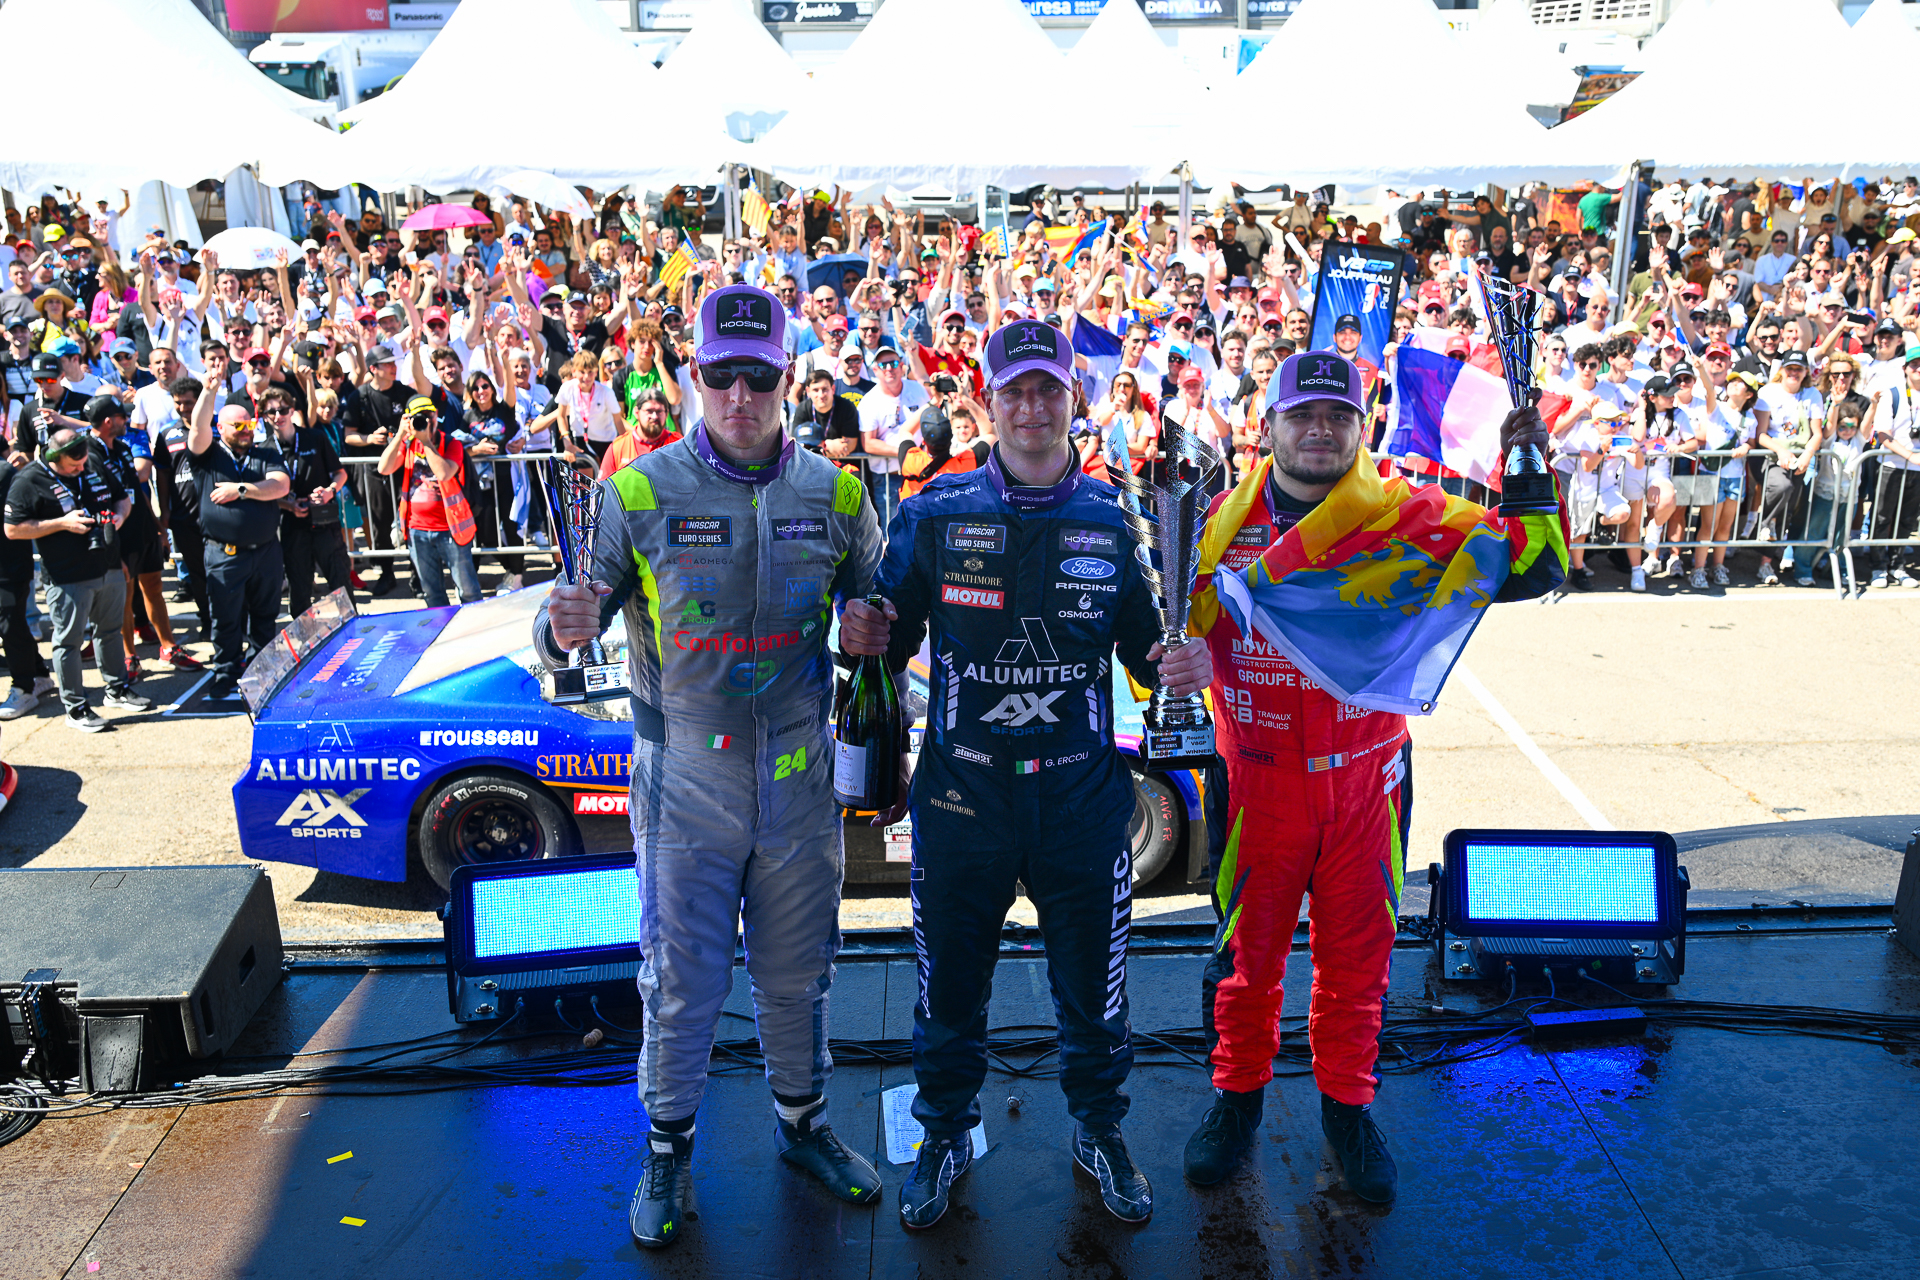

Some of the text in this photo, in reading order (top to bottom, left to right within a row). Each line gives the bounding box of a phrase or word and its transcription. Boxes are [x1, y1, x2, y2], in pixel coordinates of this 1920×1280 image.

[1145, 1, 1223, 14] DRIVALIA
[394, 12, 444, 21] Panasonic
[1339, 254, 1396, 273] V8GP
[1327, 268, 1393, 285] JOUFFREAU
[1379, 286, 1391, 310] Paul
[720, 320, 767, 331] HOOSIER
[1008, 343, 1054, 356] HOOSIER
[1300, 378, 1346, 389] HOOSIER
[717, 464, 758, 481] HOOSIER
[1012, 494, 1055, 502] HOOSIER
[688, 521, 720, 529] NASCAR
[776, 524, 823, 533] HOOSIER
[678, 534, 722, 543] EURO SERIES
[967, 527, 996, 537] NASCAR
[954, 538, 996, 550] EURO SERIES
[1064, 535, 1113, 546] HOOSIER
[1244, 536, 1262, 544] SERIES
[1071, 559, 1105, 577] Ford
[944, 571, 1003, 587] STRATHMORE
[788, 580, 818, 594] WRK
[1055, 582, 1117, 592] RACING
[788, 595, 817, 609] MKT
[944, 587, 1001, 607] MOTUL
[681, 616, 717, 625] GROUP
[674, 630, 799, 655] Conforama
[1231, 657, 1296, 670] CONSTRUCTIONS
[963, 662, 1087, 685] ALUMITEC
[1238, 669, 1296, 687] GROUPE
[1257, 710, 1292, 721] TRAVAUX
[990, 724, 1054, 736] SPORTS
[1257, 719, 1290, 730] PUBLICS
[433, 729, 539, 746] rousseau
[536, 753, 634, 777] STRATH
[774, 746, 807, 781] 24
[1045, 751, 1089, 767] G. ERCOLI
[256, 757, 421, 781] ALUMITEC
[468, 785, 528, 801] HOOSIER
[930, 797, 976, 817] STRATHMORE
[291, 827, 363, 839] SPORTS
[1162, 827, 1173, 842] FR
